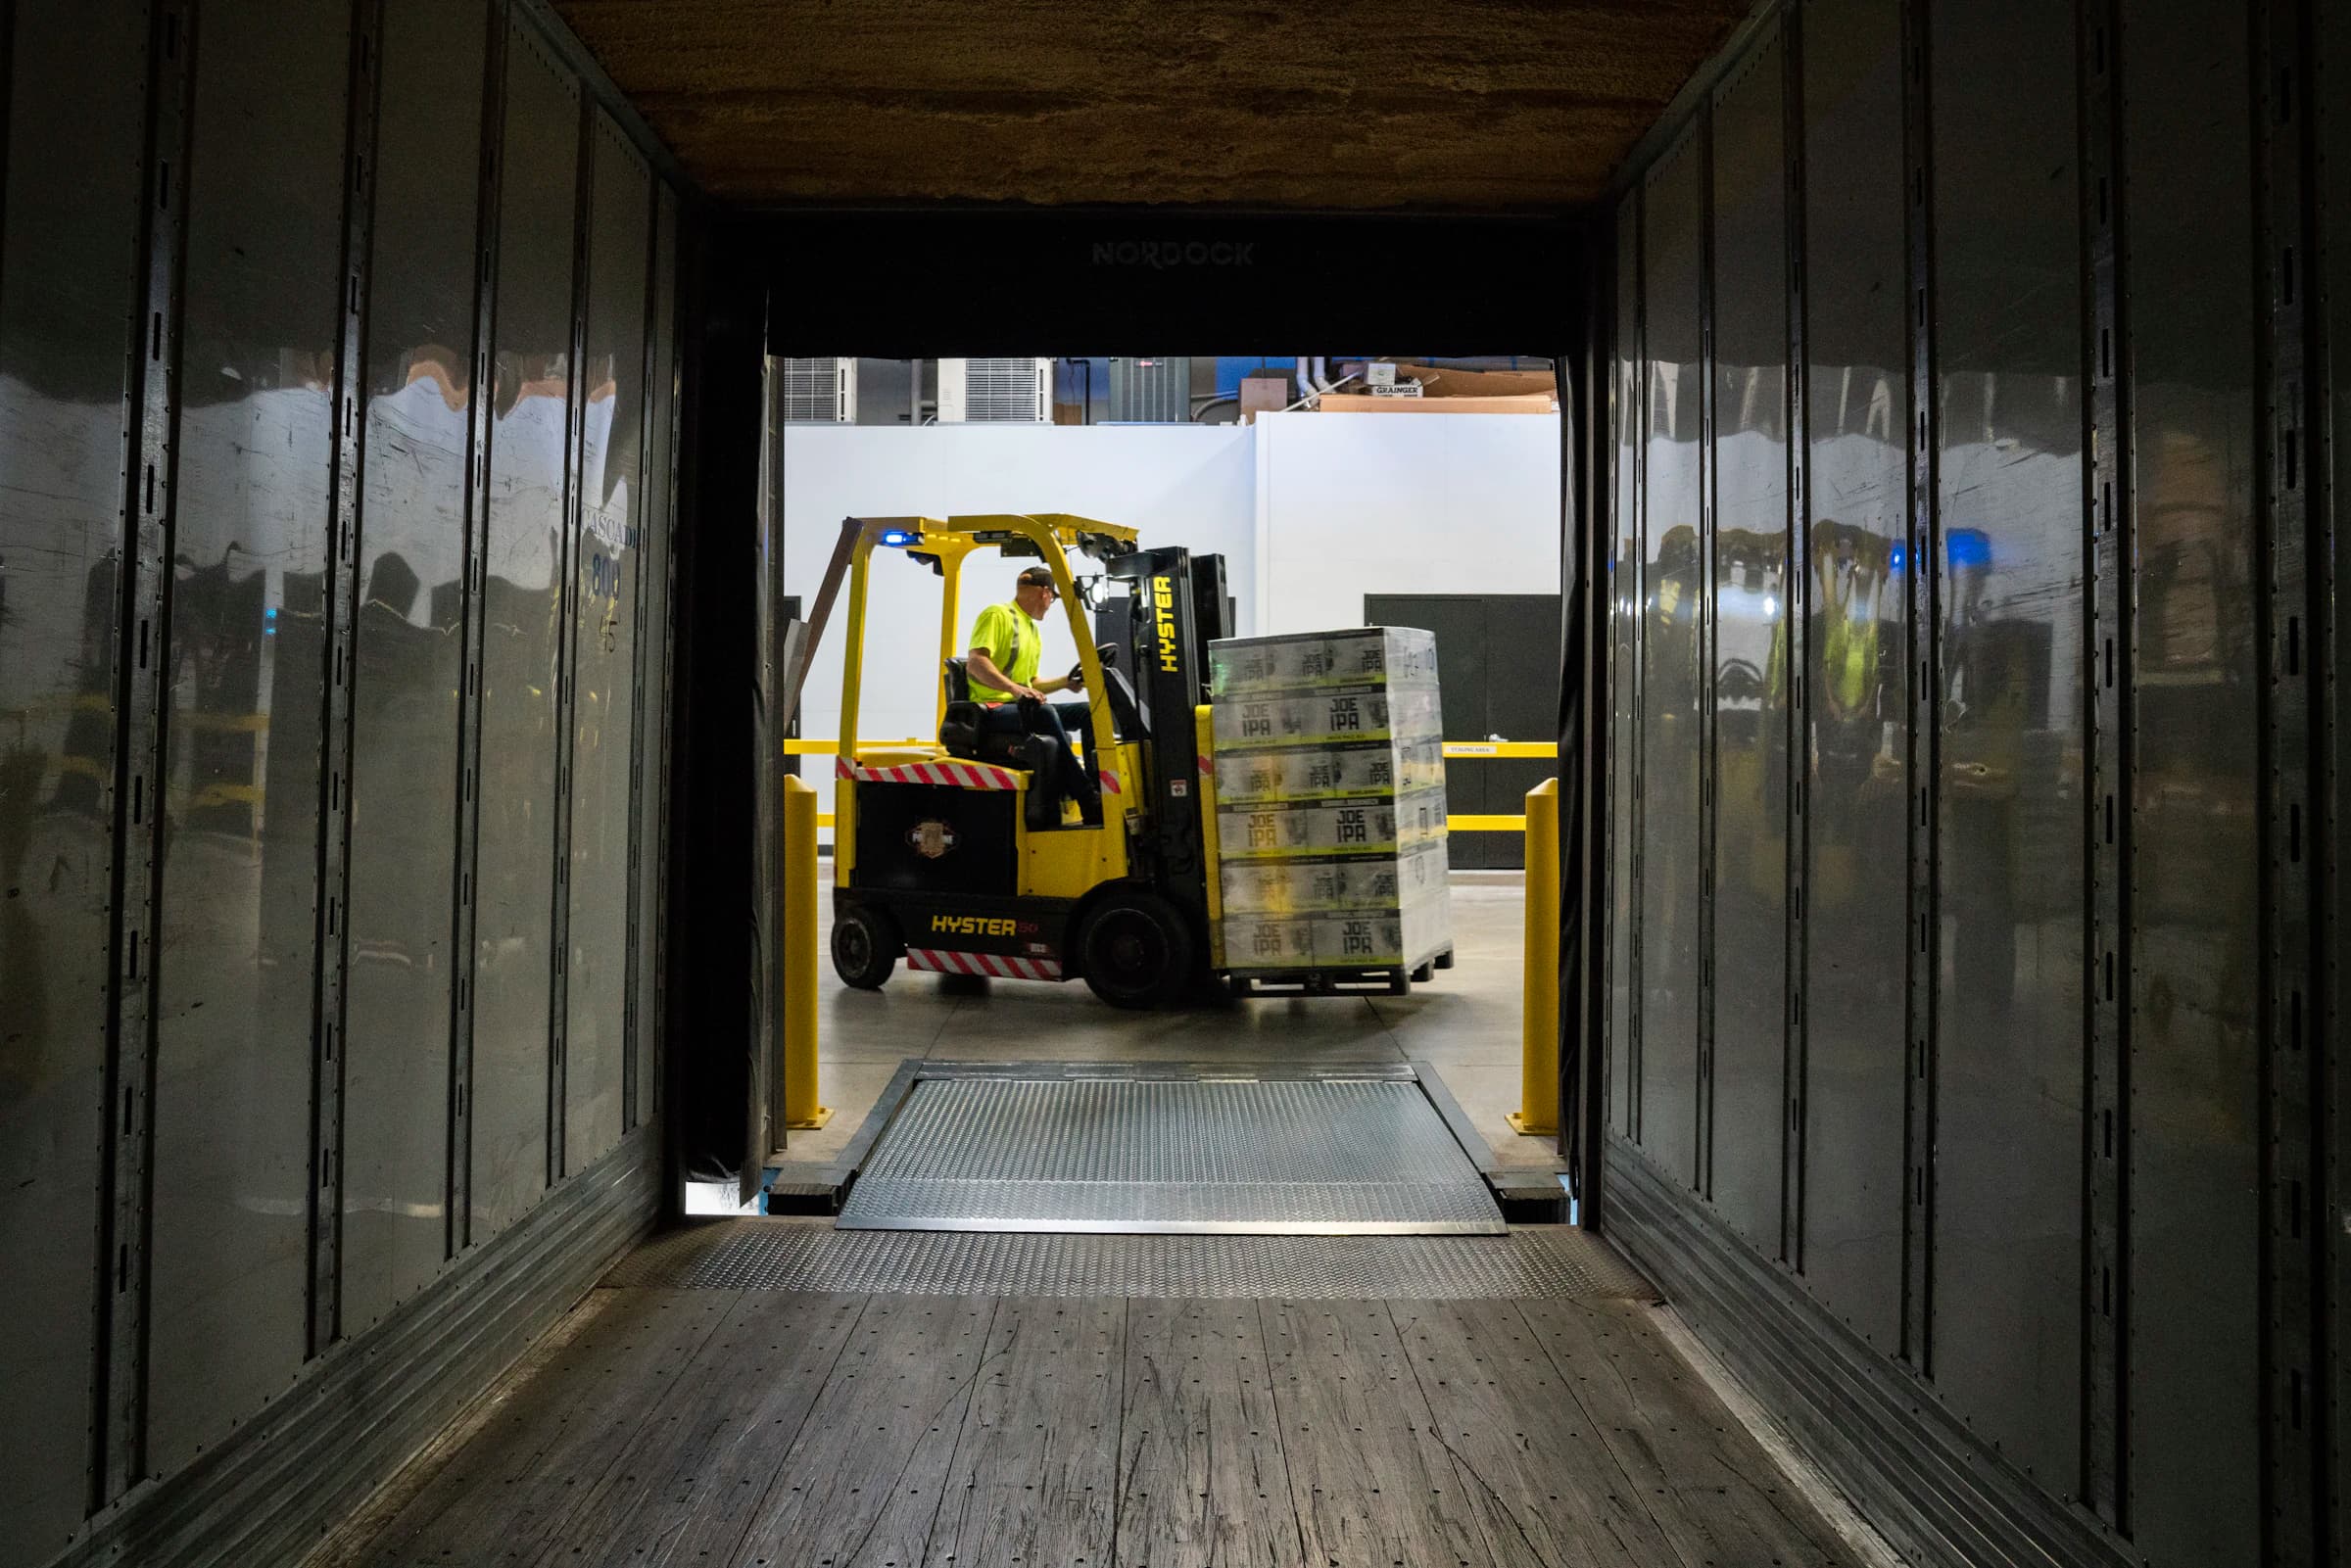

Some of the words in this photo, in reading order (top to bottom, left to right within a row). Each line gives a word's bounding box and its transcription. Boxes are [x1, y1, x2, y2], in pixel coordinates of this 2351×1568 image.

[1092, 242, 1254, 270] NORDOCK
[1154, 576, 1177, 672] HYSTER
[1242, 704, 1270, 719] JOE
[1329, 697, 1359, 713] JOE
[1242, 719, 1271, 736] IPA
[1330, 712, 1360, 732] IPA
[1310, 776, 1330, 788] IPA
[1370, 773, 1390, 785] IPA
[1247, 814, 1274, 829] JOE
[1336, 810, 1365, 825] JOE
[1247, 829, 1276, 847] IPA
[1337, 826, 1367, 843] IPA
[932, 915, 1017, 936] HYSTER
[1254, 924, 1280, 938] JOE
[1342, 922, 1371, 935] JOE
[1254, 938, 1281, 956] IPA
[1343, 936, 1373, 954] IPA
